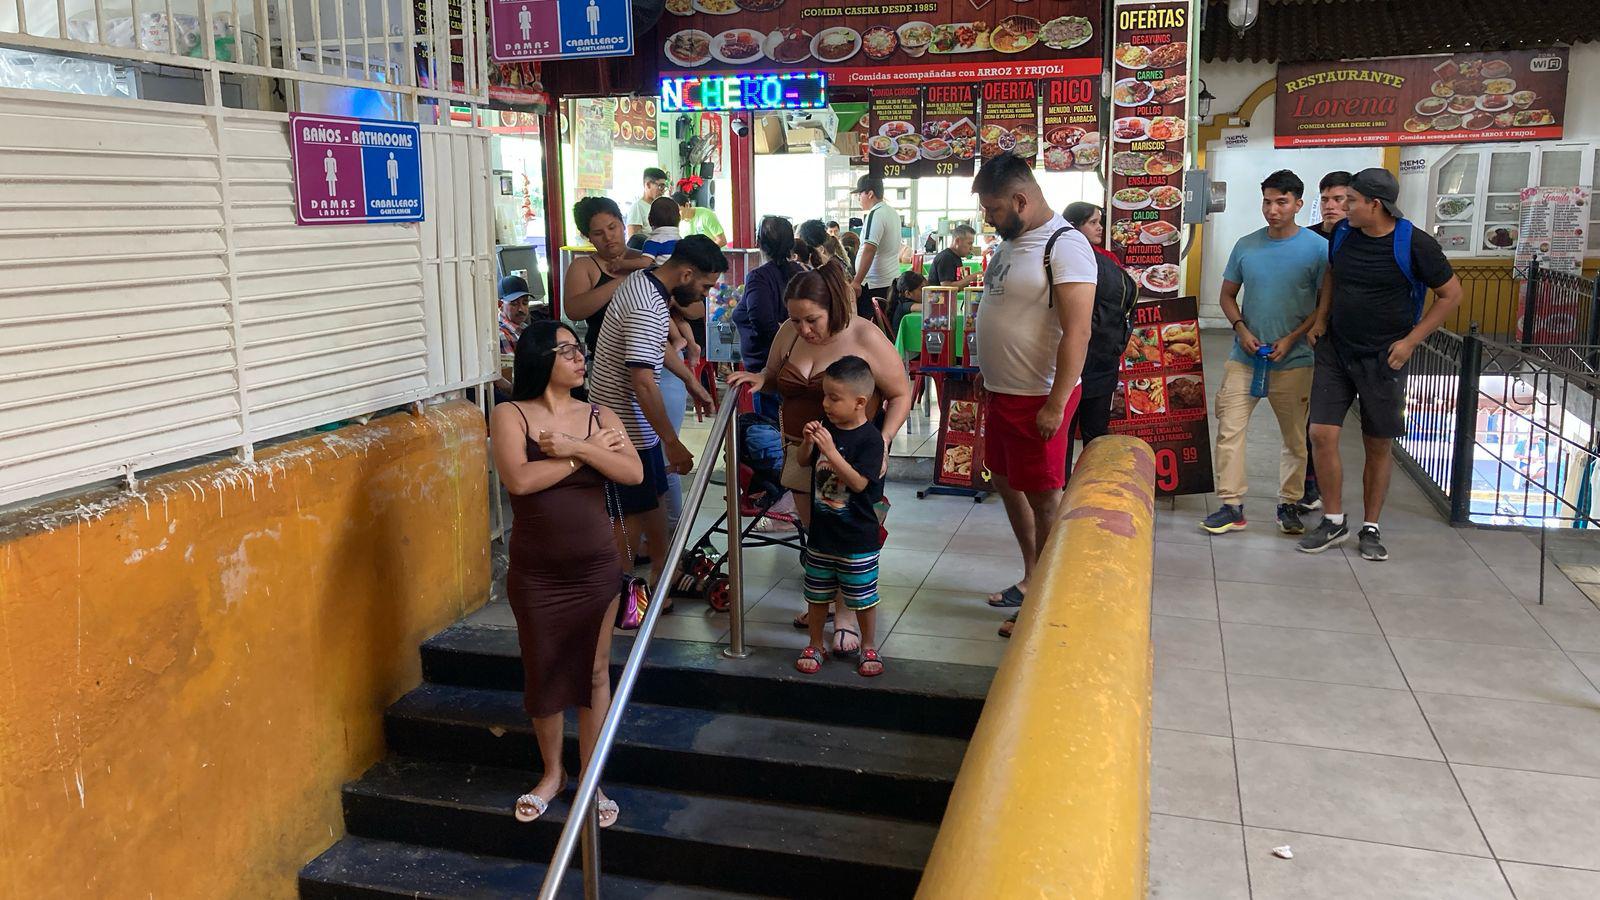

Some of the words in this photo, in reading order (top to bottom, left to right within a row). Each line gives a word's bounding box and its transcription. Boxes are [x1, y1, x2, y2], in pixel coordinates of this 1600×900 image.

[801, 8, 842, 18] ¡COMIDA
[844, 6, 880, 15] CASERA
[882, 4, 912, 14] DESDE
[914, 4, 936, 12] 1985!
[1120, 8, 1184, 30] OFERTAS
[566, 36, 624, 46] CABALLEROS
[1132, 34, 1170, 44] DESAYUNOS
[505, 42, 550, 50] DAMAS
[848, 73, 892, 82] ¡Comidas
[894, 69, 956, 80] acompañadas
[978, 68, 1012, 76] ARROZ
[1024, 65, 1064, 76] FRIJOL!
[1137, 70, 1164, 80] CARNES
[1285, 70, 1405, 94] RESTAURANTE
[872, 88, 893, 96] COMIDA
[894, 87, 918, 96] CORRIDA
[928, 86, 972, 102] OFERTA
[984, 81, 1034, 100] OFERTA
[1050, 79, 1092, 104] RICO
[1136, 106, 1162, 115] POLLOS
[1292, 95, 1397, 117] Lorena
[1070, 115, 1096, 124] BARBACOA
[302, 124, 342, 142] BAÑOS
[352, 130, 413, 147] BATHROOMS
[1132, 142, 1165, 150] MARISCOS
[884, 165, 900, 176] $79
[936, 163, 953, 174] $79
[1128, 176, 1166, 185] ENSALADAS
[311, 200, 356, 208] DAMAS
[371, 200, 418, 208] CABALLEROS
[1133, 211, 1158, 220] CALDOS
[1128, 245, 1162, 254] ANTOJITOS
[1126, 254, 1163, 264] MEXICANOS
[1156, 448, 1179, 492] 9
[1183, 447, 1198, 460] 99
